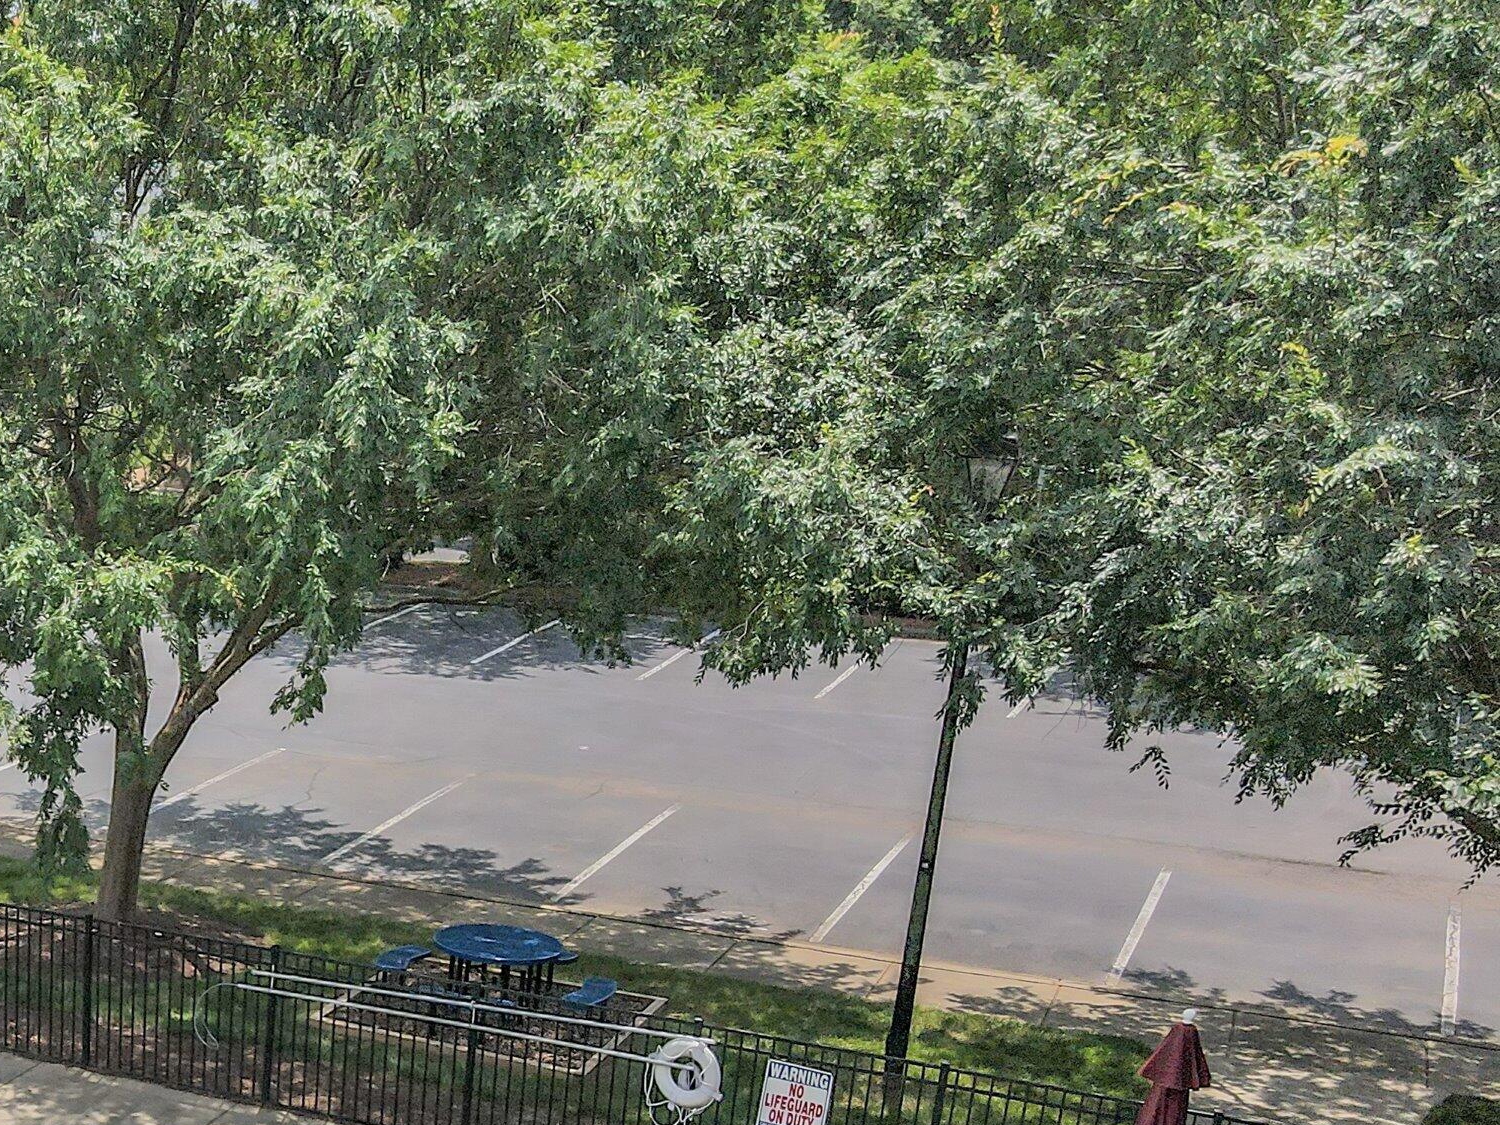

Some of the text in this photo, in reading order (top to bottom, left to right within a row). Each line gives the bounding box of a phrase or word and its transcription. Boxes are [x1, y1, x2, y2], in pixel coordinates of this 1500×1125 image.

[771, 1063, 828, 1088] WARNING
[789, 1084, 804, 1098] NO
[765, 1093, 823, 1117] LIFEGUARD
[769, 1109, 783, 1124] ON
